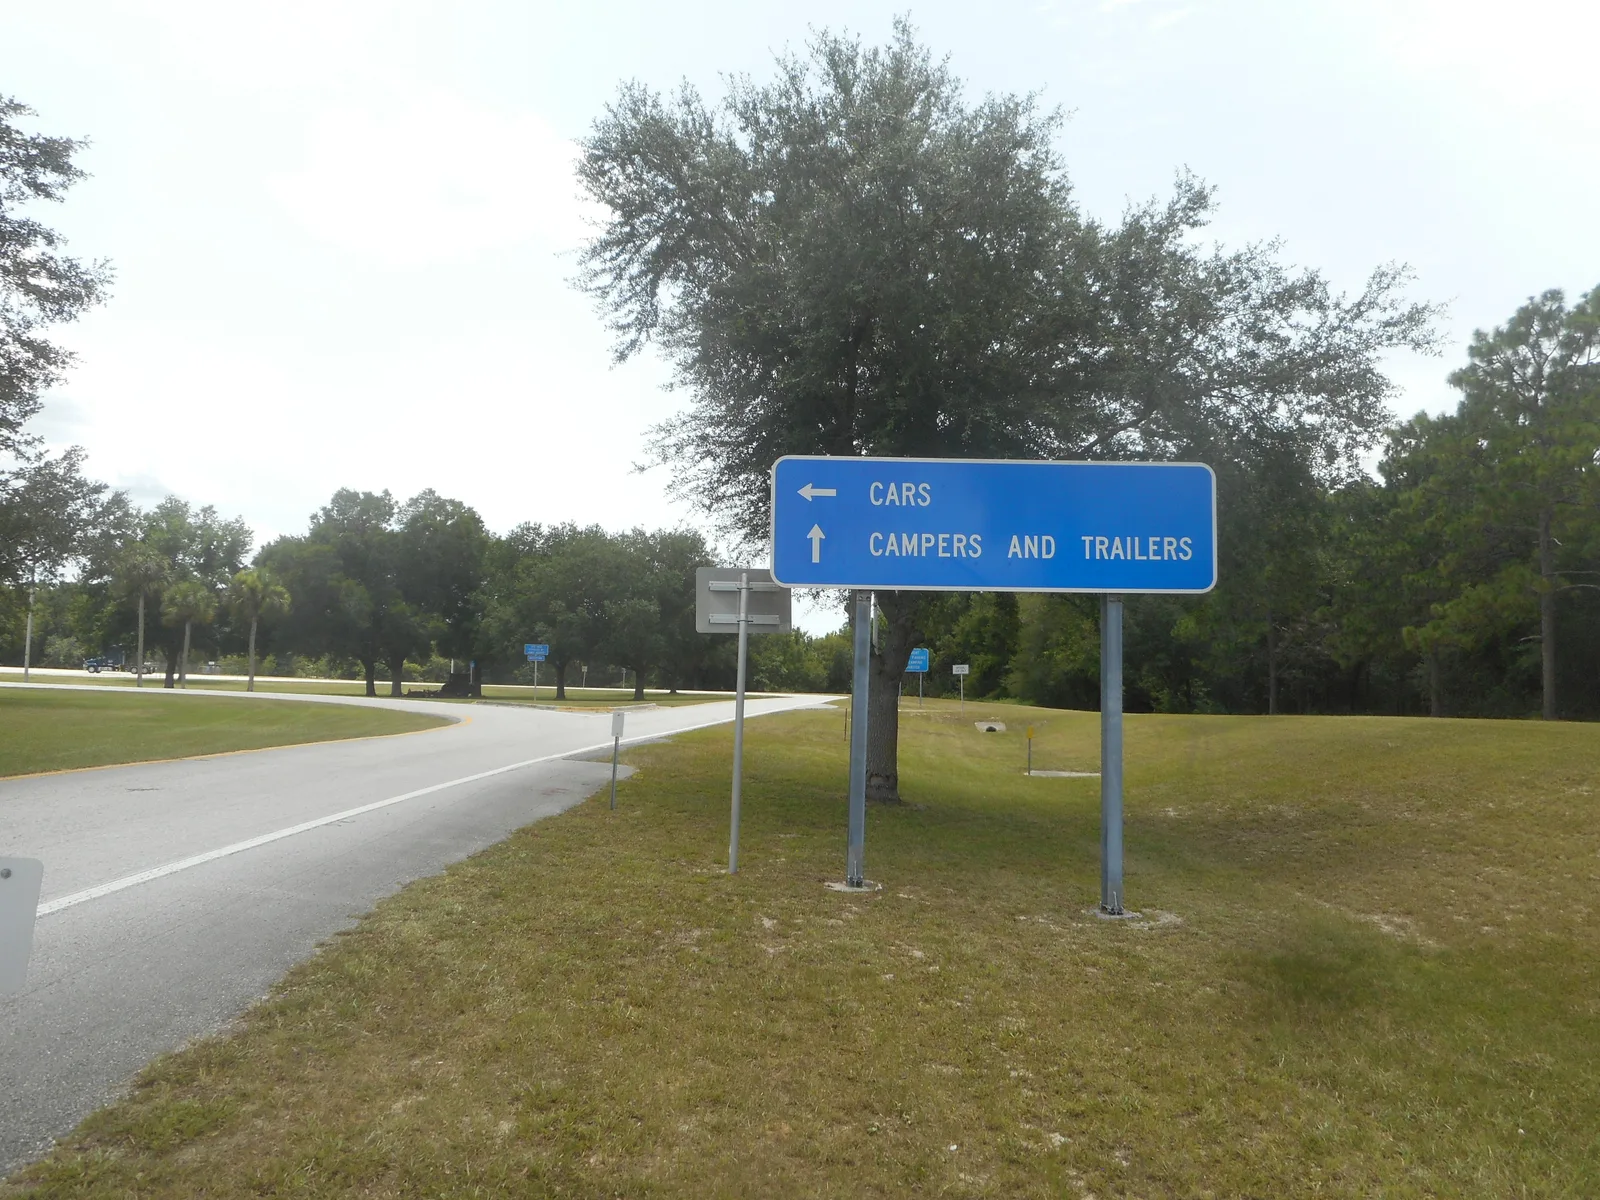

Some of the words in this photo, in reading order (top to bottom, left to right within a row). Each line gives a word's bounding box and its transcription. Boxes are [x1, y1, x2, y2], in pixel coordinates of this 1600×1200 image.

[869, 481, 931, 507] CARS
[869, 532, 982, 558] CAMPERS
[1007, 535, 1056, 559] AND
[1081, 536, 1192, 561] TRAILERS
